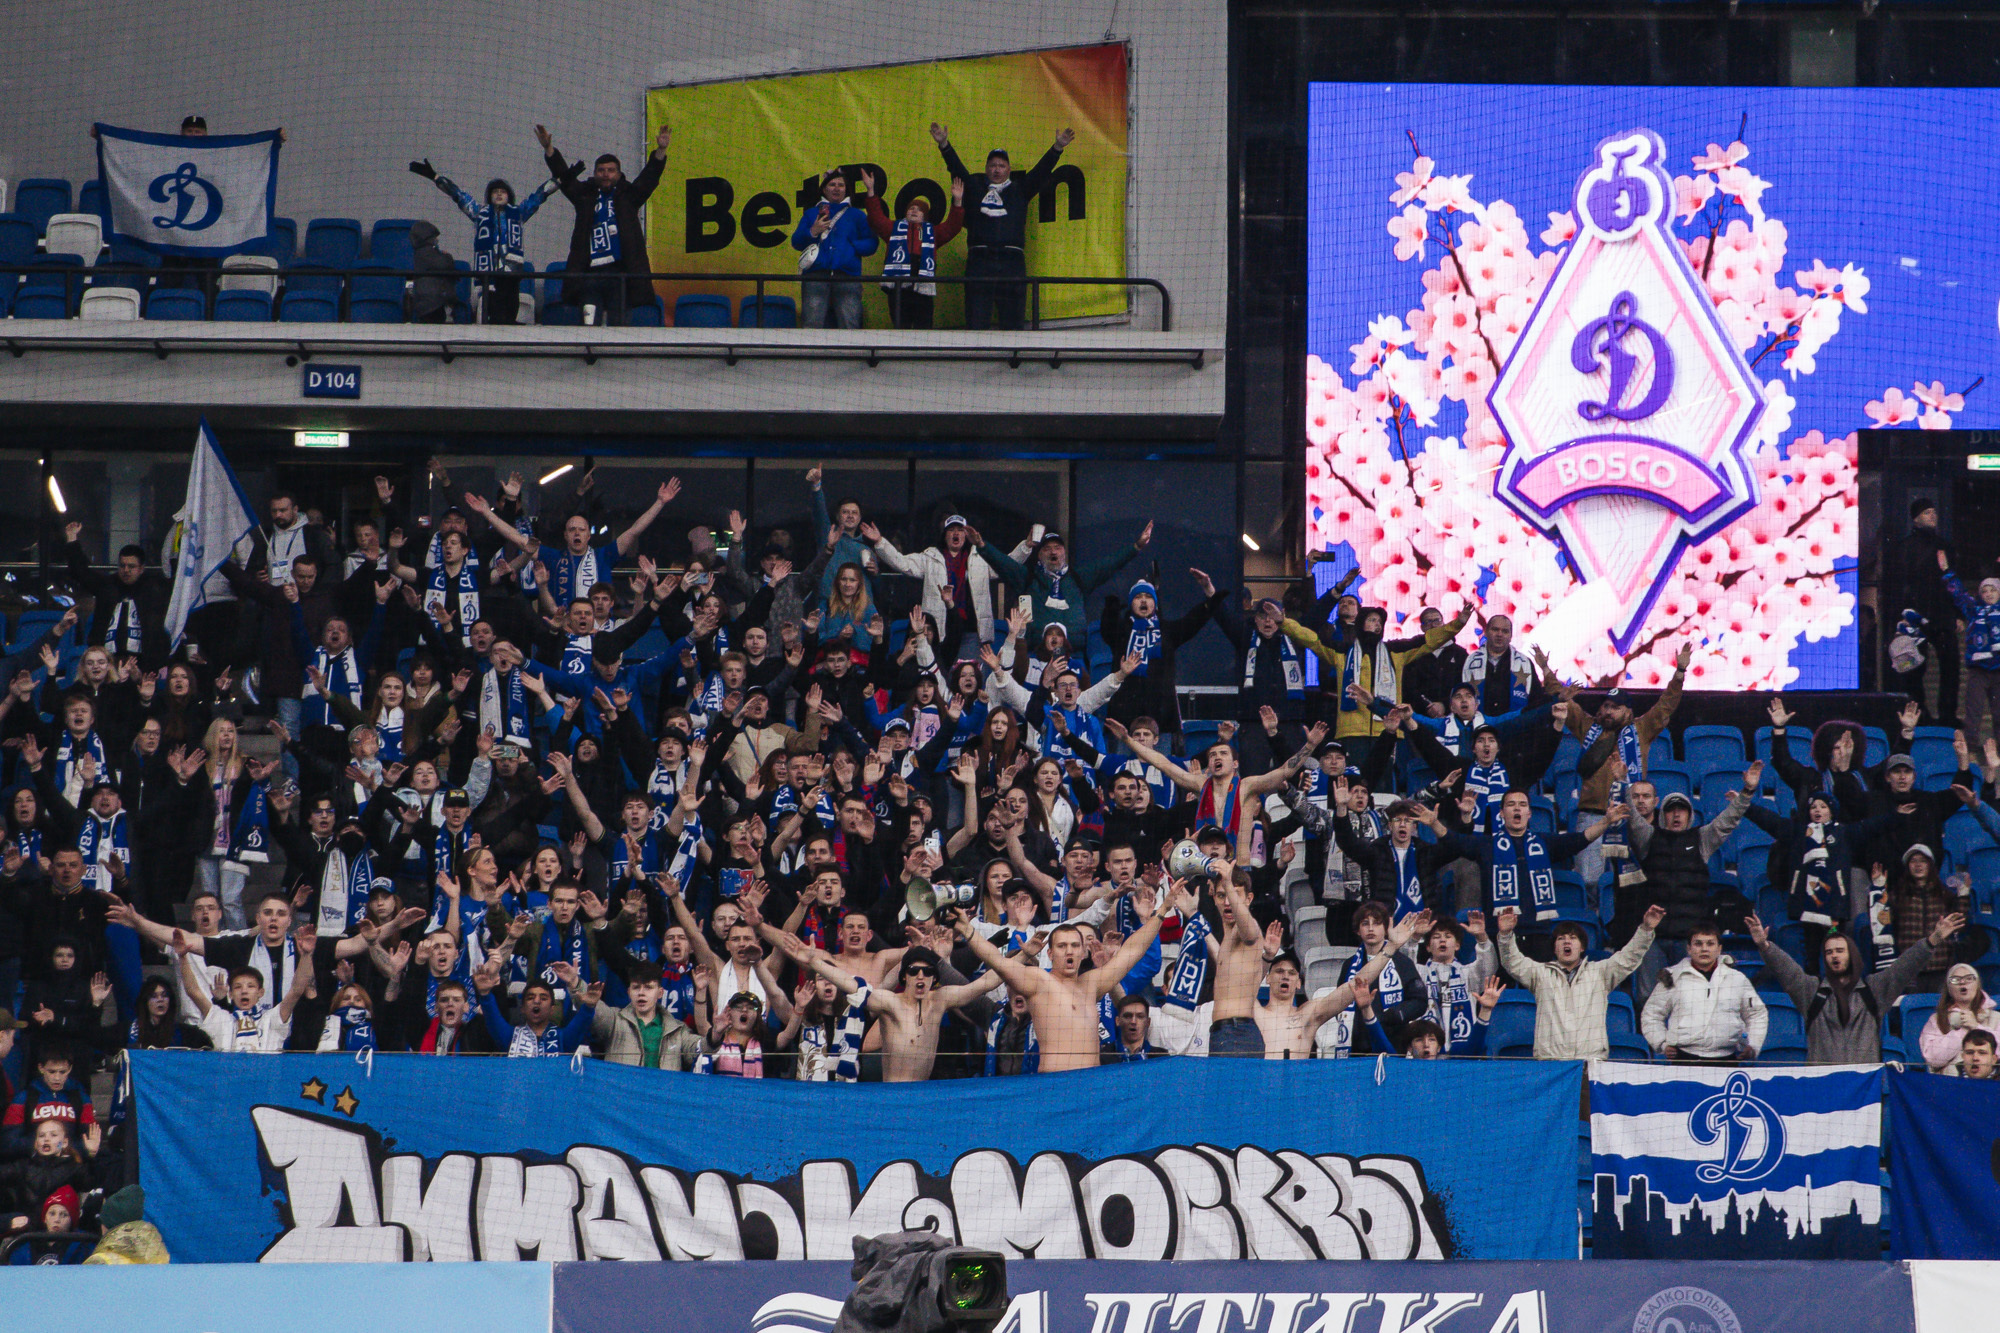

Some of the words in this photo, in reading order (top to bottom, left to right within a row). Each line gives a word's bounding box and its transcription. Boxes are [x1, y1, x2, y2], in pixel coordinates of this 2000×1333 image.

[685, 164, 1086, 253] BetBom
[309, 371, 322, 388] D
[325, 372, 356, 389] 104
[305, 435, 339, 446] ВЫХОД
[1556, 453, 1676, 489] BOSCO
